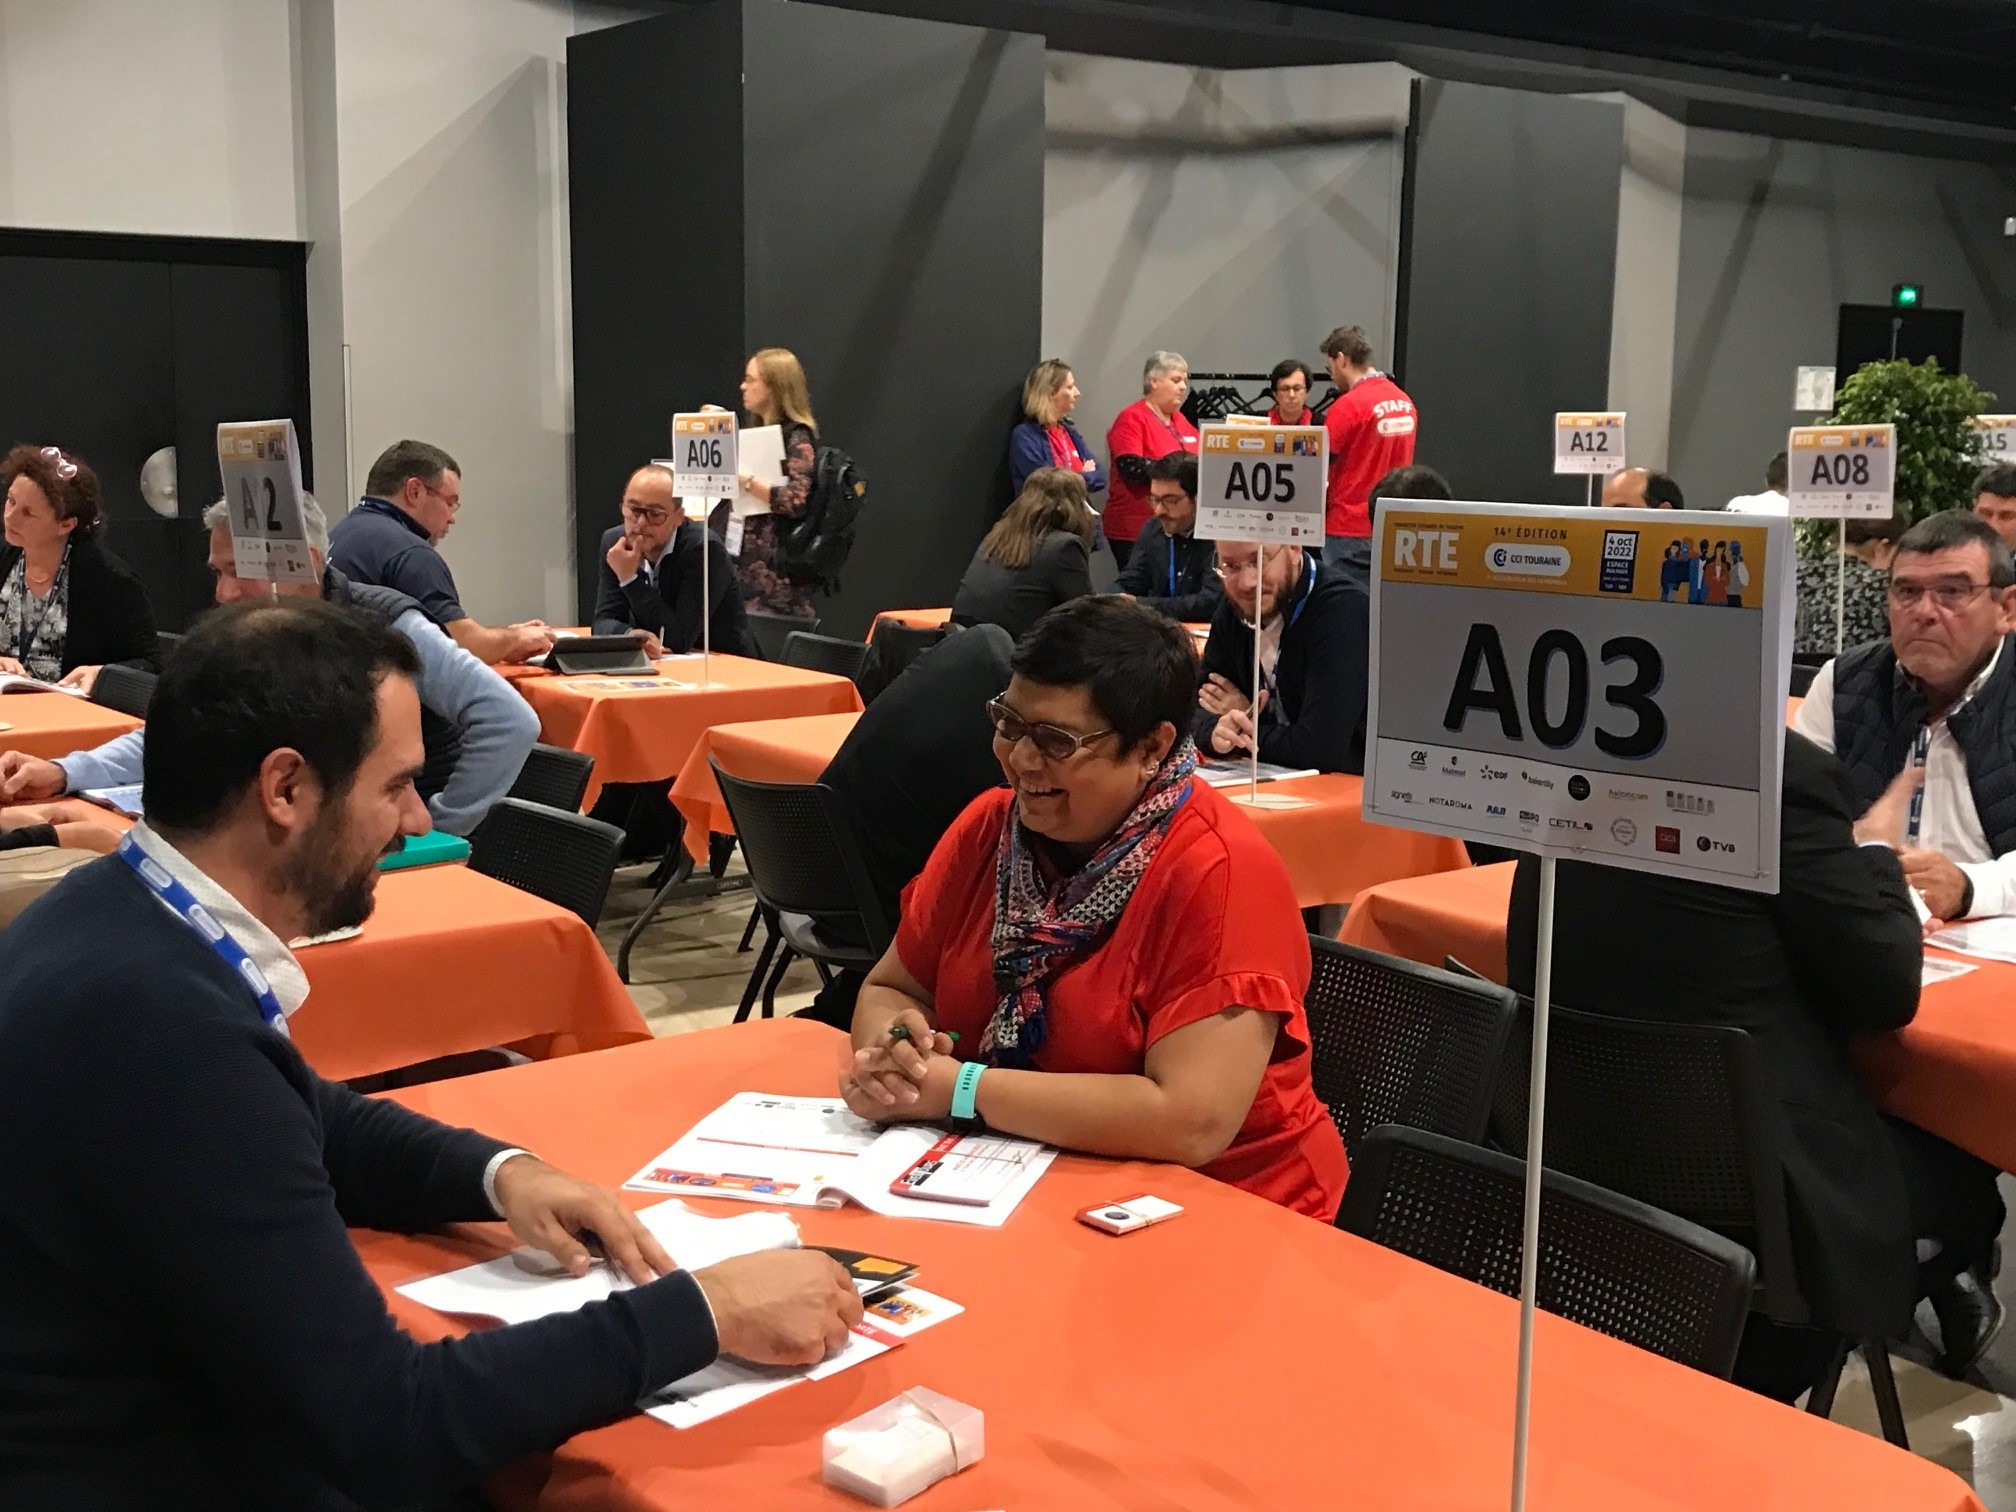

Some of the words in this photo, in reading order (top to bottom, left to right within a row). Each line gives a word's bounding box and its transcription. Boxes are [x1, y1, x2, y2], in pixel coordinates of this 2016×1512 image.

[1373, 399, 1412, 418] STAFF
[1206, 434, 1230, 449] RTE
[1570, 431, 1608, 452] A12
[687, 438, 722, 468] A06
[1811, 453, 1870, 486] A08
[1225, 461, 1296, 503] A05
[1516, 526, 1568, 540] ÉDITION
[1608, 536, 1615, 546] 4
[1617, 537, 1633, 547] oct
[1394, 529, 1461, 569] RTE
[1607, 546, 1632, 557] 2022
[1510, 554, 1523, 564] CCI
[1524, 555, 1562, 567] TOURAINE
[1443, 623, 1668, 761] A03
[1429, 797, 1473, 811] NOTAROMA
